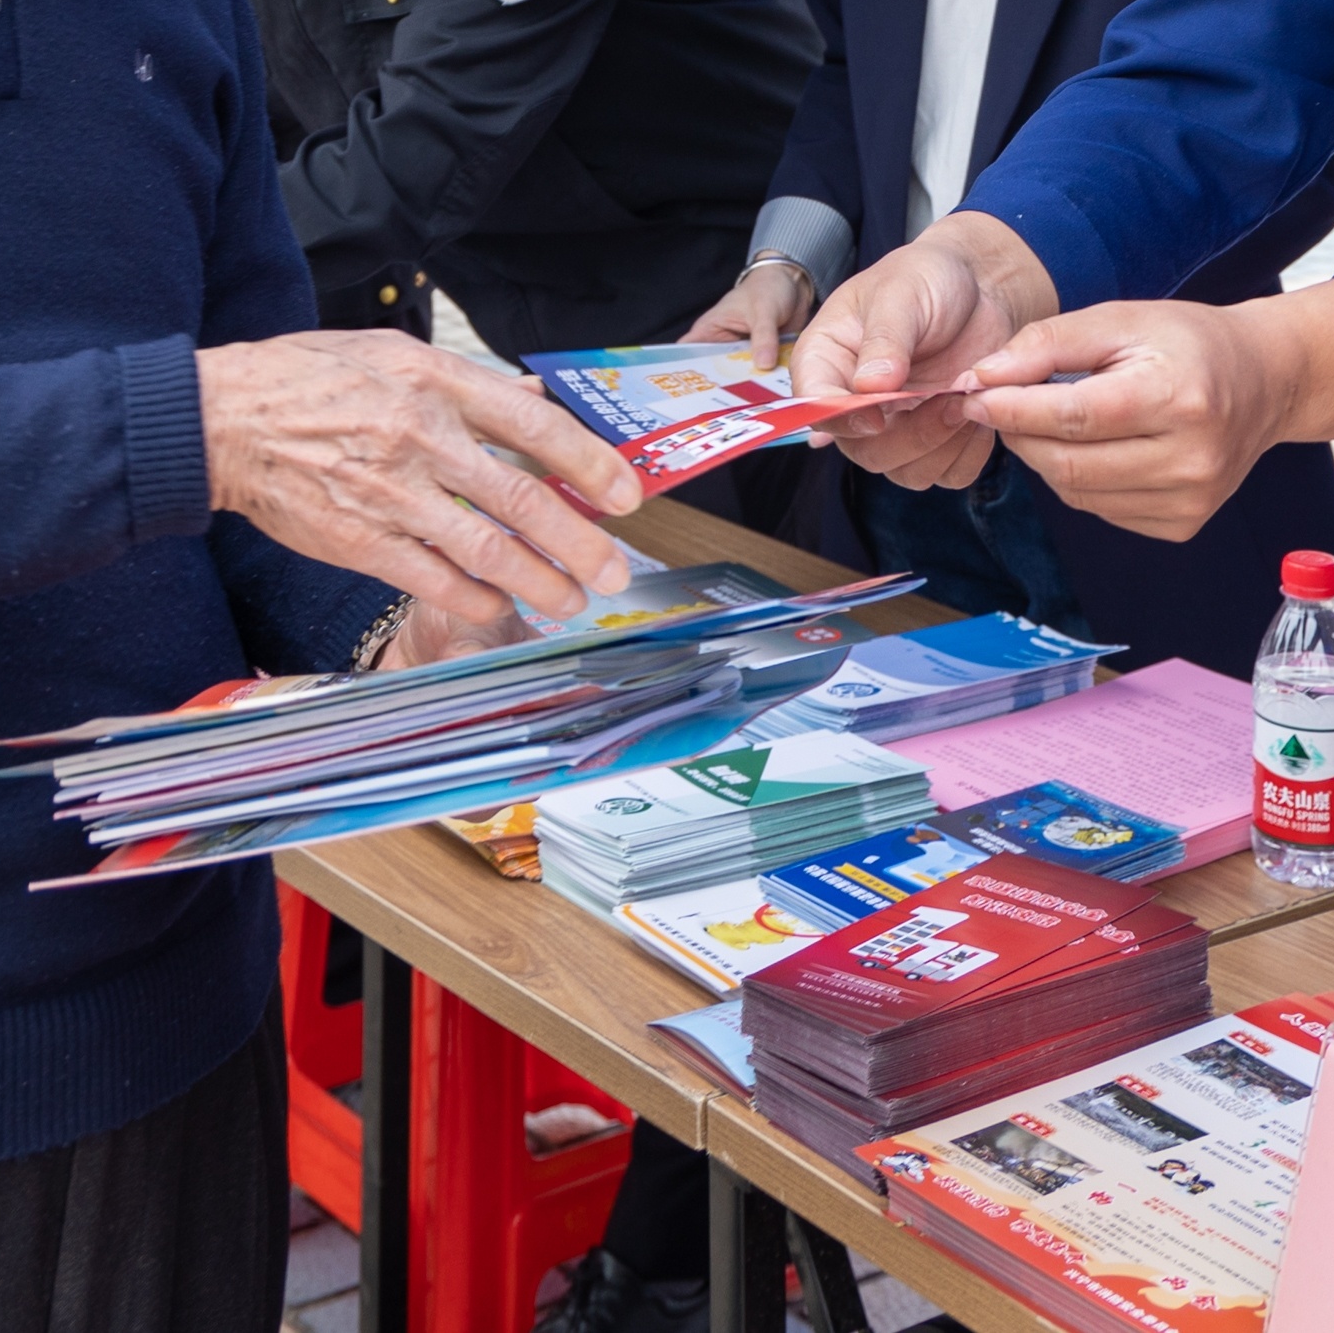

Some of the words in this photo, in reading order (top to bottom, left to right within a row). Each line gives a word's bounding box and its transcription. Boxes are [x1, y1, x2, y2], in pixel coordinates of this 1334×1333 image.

[1262, 780, 1330, 812] 农夫山泉
[1263, 800, 1294, 821] NONGFU
[1295, 807, 1331, 824] SPRING
